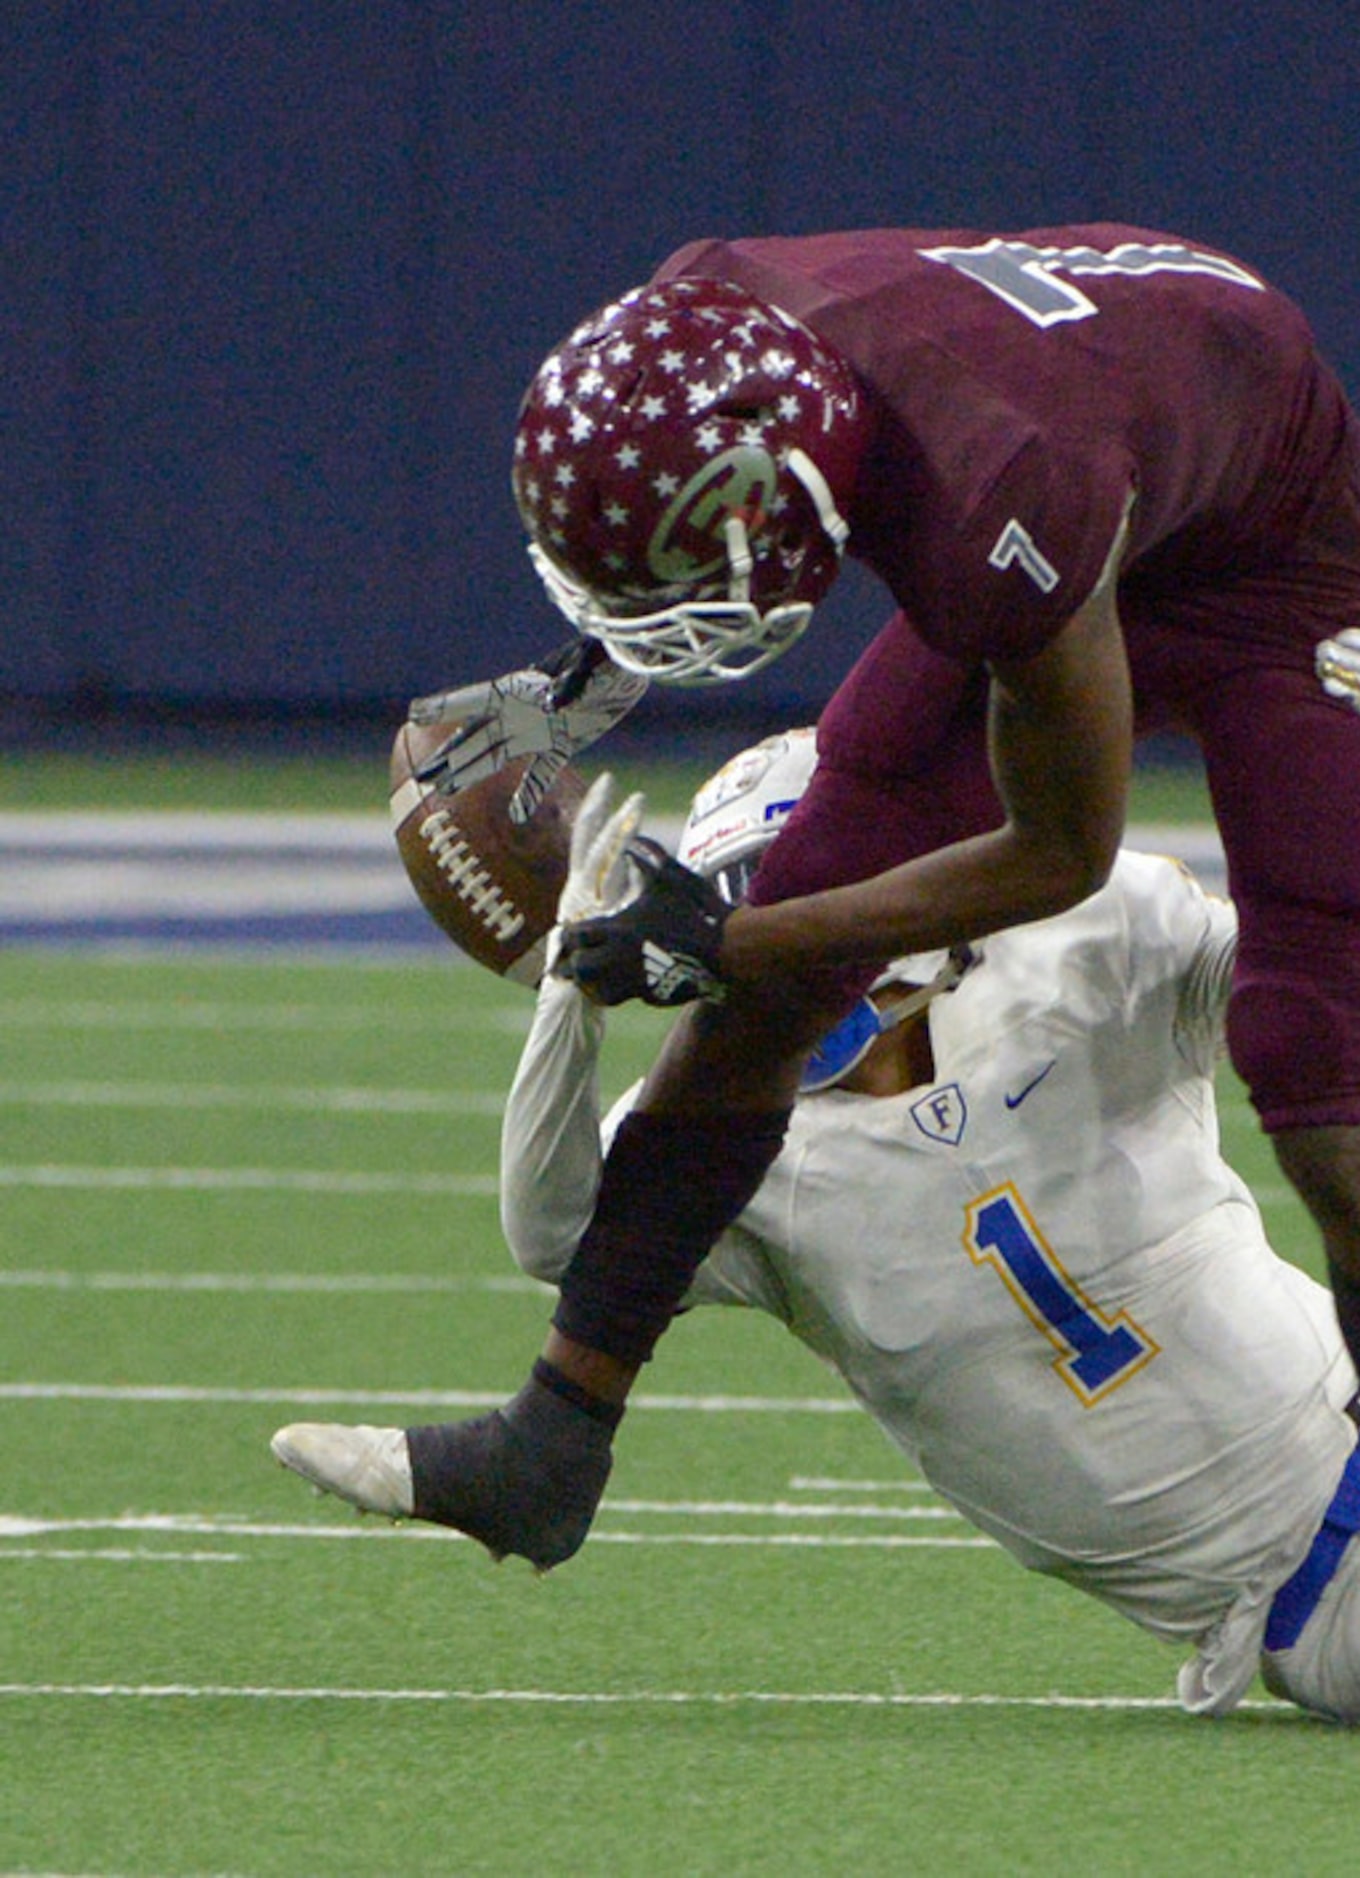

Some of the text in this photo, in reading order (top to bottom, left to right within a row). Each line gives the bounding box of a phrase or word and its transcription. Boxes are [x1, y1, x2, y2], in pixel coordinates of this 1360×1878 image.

[988, 518, 1060, 593] 7
[929, 1094, 952, 1132] F
[962, 1179, 1162, 1409] 1
